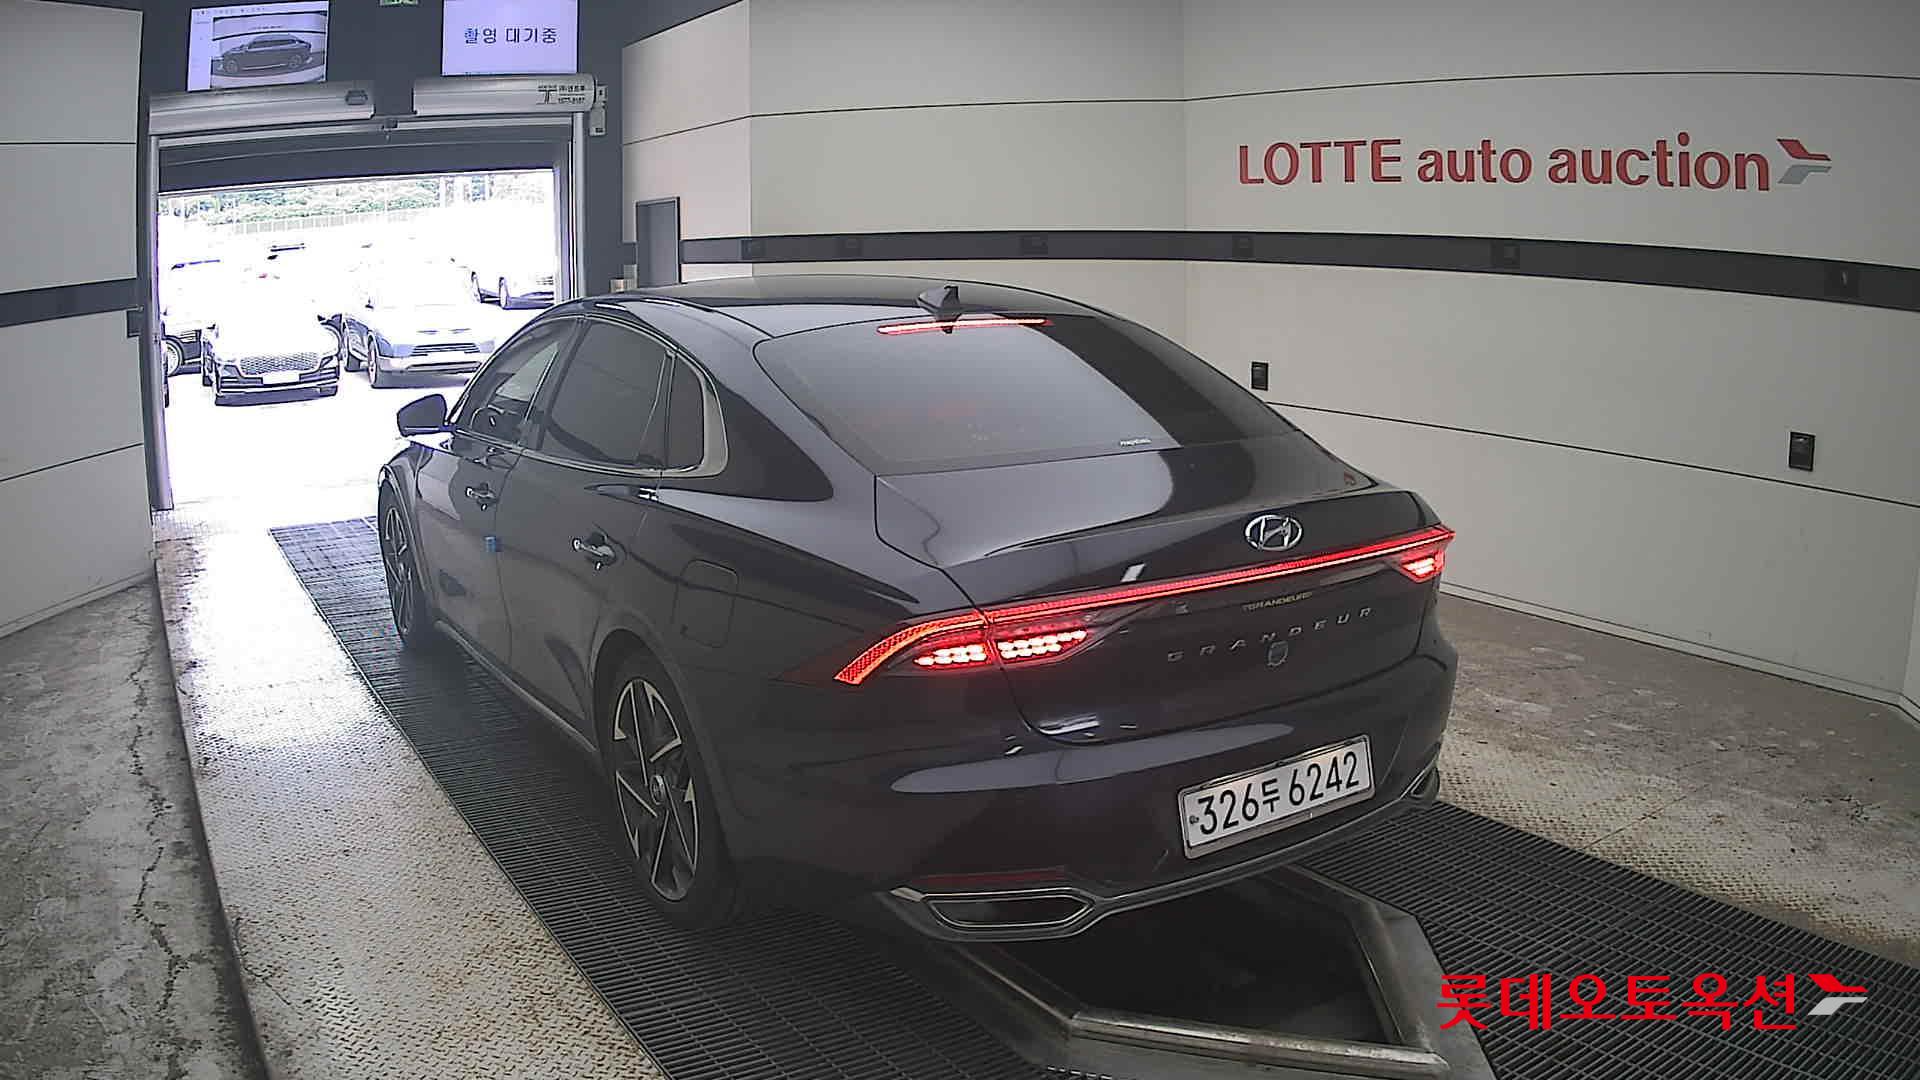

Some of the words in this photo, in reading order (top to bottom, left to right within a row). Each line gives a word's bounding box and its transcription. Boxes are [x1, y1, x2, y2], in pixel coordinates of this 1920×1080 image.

[505, 27, 558, 44] 대기중
[1239, 138, 1402, 185] LOTTE
[1417, 138, 1532, 184] auto
[1548, 131, 1771, 192] auction
[1166, 606, 1373, 662] GRANDEUR
[1197, 777, 1281, 835] 326두
[1288, 751, 1360, 806] 6242
